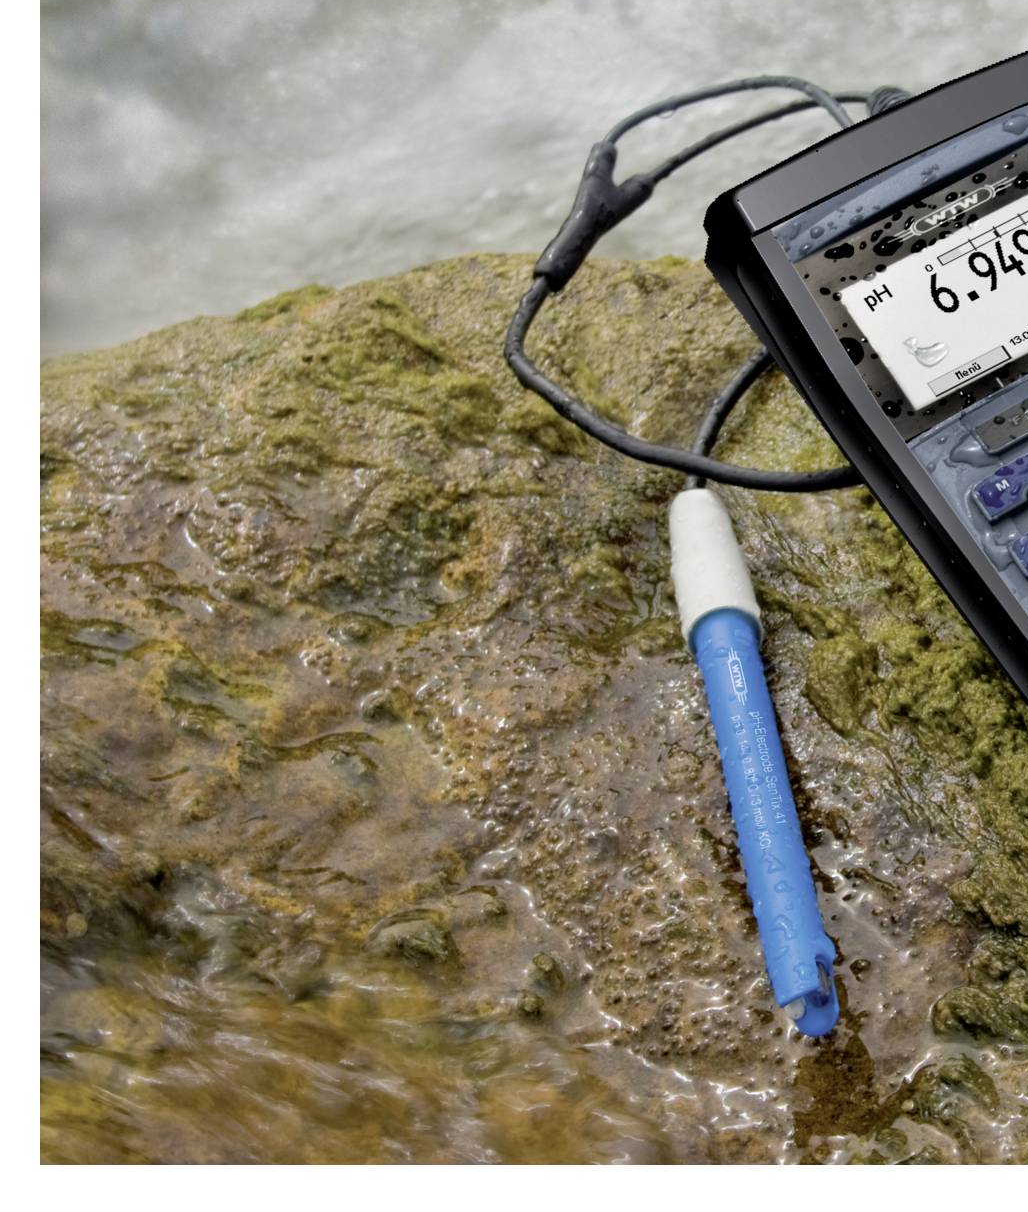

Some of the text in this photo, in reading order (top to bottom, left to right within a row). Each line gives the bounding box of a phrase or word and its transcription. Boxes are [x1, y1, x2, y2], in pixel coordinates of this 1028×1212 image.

[925, 193, 979, 226] WTW
[924, 263, 934, 273] 0
[863, 284, 893, 311] pH
[955, 362, 982, 381] Menü
[995, 479, 1010, 493] M
[731, 663, 745, 689] WTW
[749, 711, 787, 824] pH-Electrode SenTix 41
